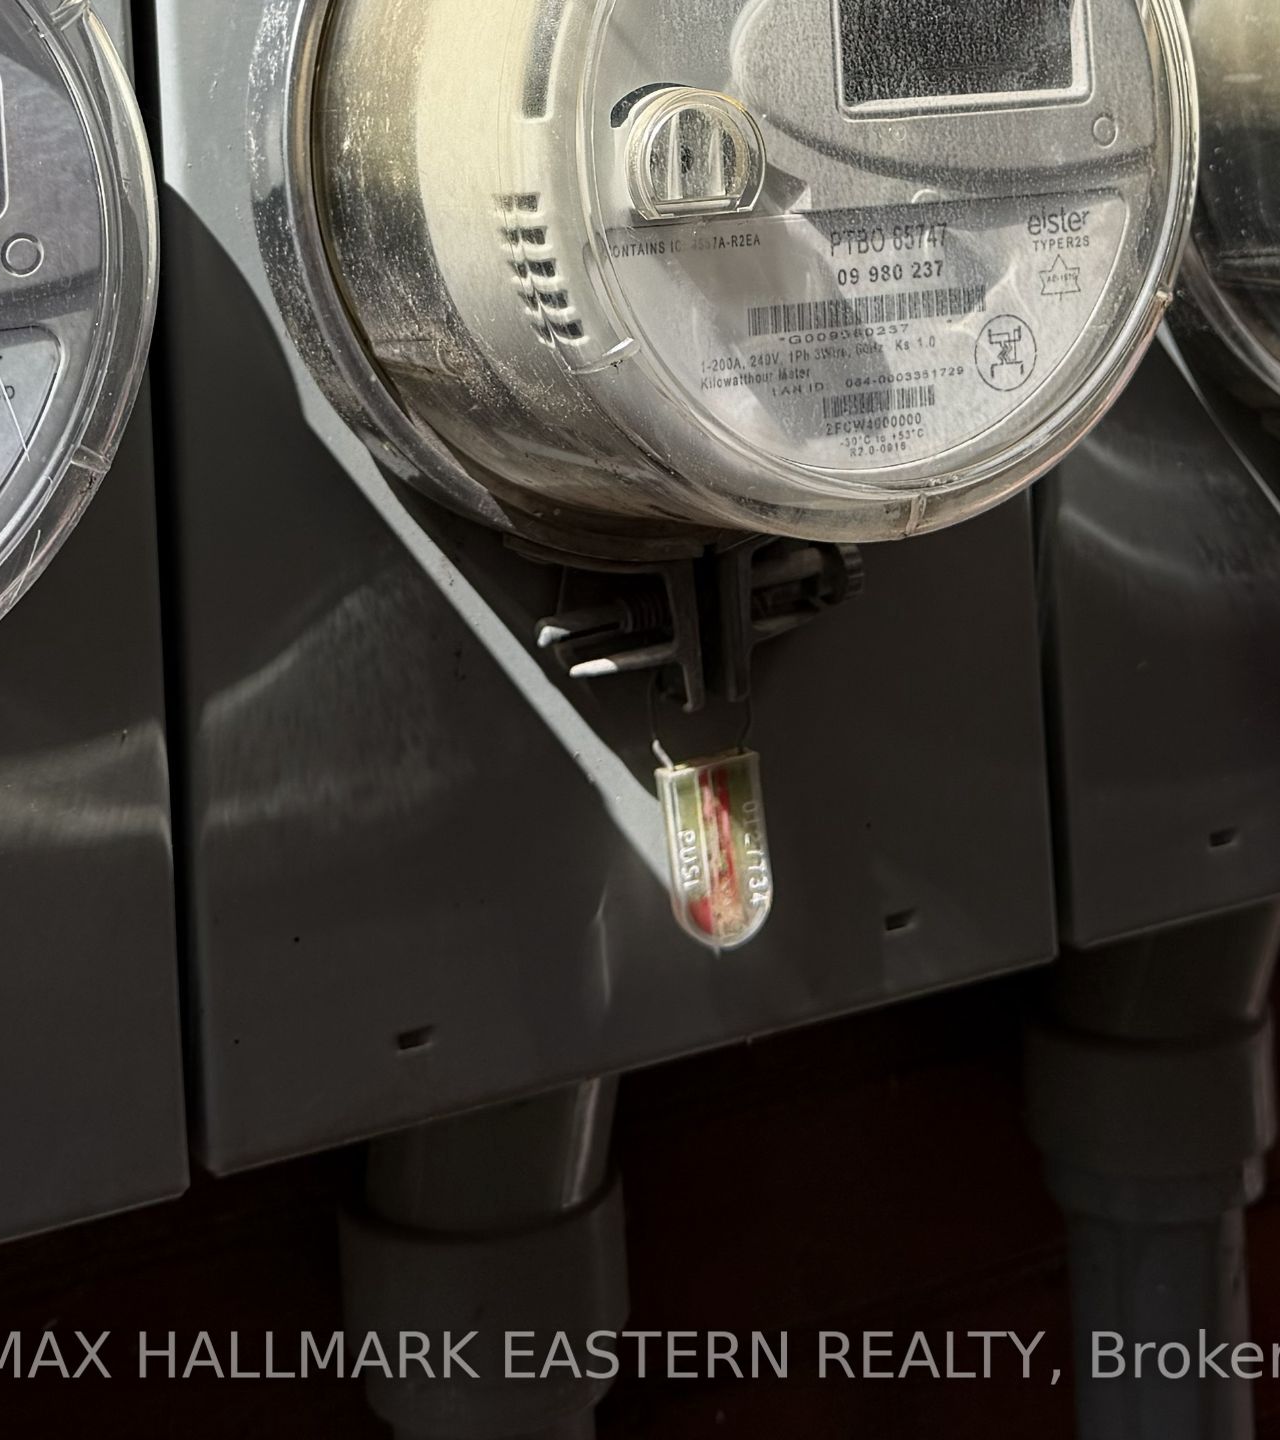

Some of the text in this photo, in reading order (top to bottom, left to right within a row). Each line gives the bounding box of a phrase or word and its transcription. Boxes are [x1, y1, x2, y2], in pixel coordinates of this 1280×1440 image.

[1027, 205, 1090, 236] elster
[837, 259, 944, 286] 09 980 237
[895, 338, 910, 352] Ks
